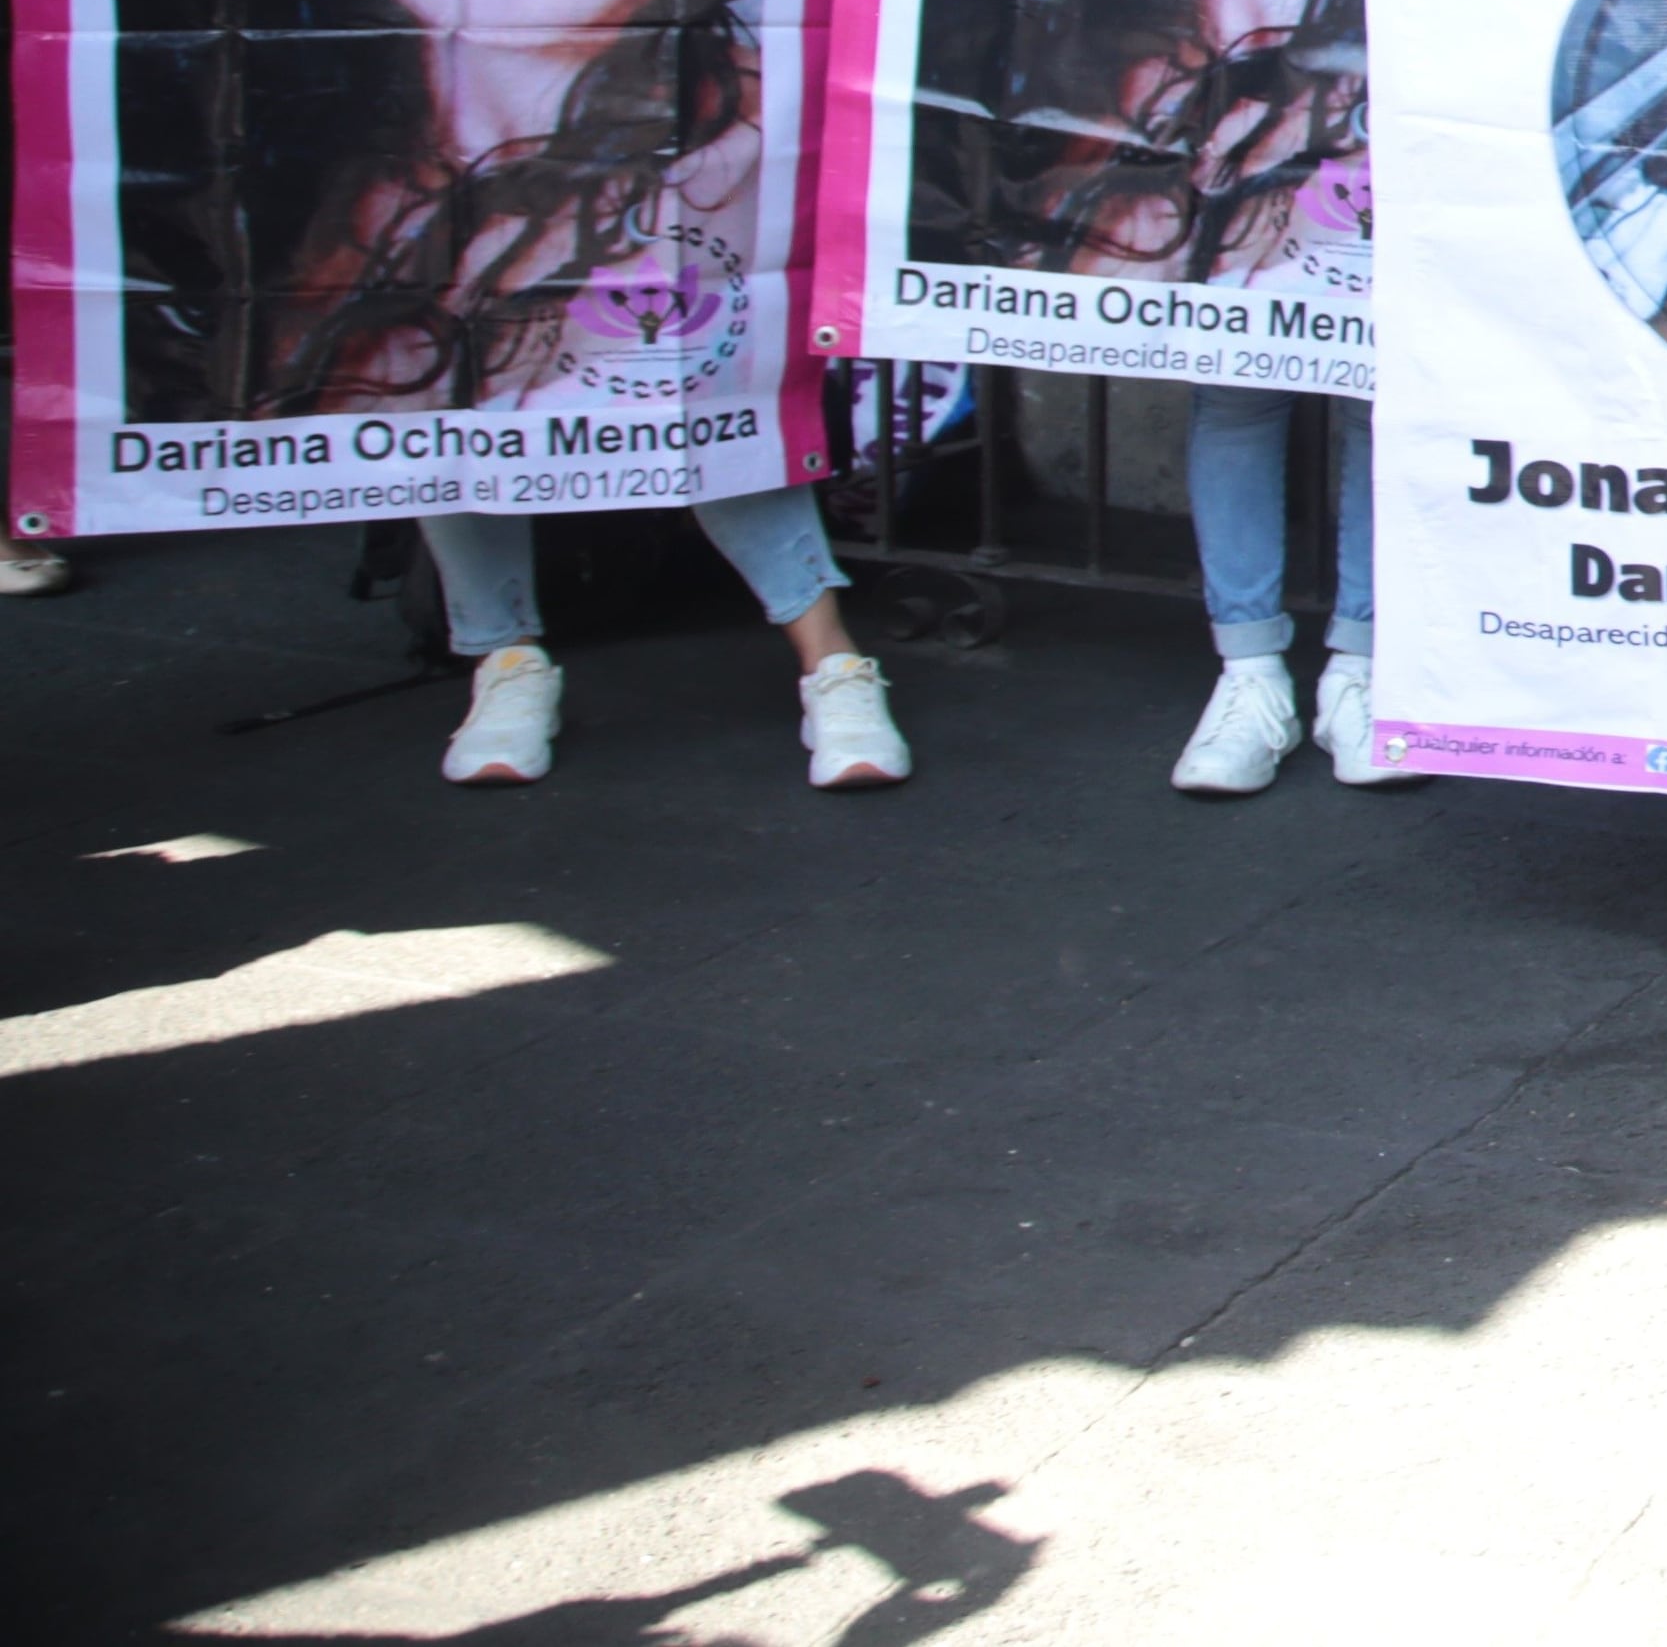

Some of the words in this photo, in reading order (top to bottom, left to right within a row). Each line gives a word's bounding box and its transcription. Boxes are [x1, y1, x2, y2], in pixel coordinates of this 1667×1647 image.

[894, 267, 1078, 321] Dariana
[1097, 285, 1249, 334] Ochoa
[965, 327, 1187, 372] Desaparecida
[1197, 348, 1221, 374] el
[111, 428, 331, 474] Dariana
[352, 419, 526, 462] Ochoa
[548, 404, 759, 456] Mendoza
[200, 469, 462, 519] Desaparecida
[474, 472, 500, 501] el
[512, 465, 705, 504] 29/01/2021
